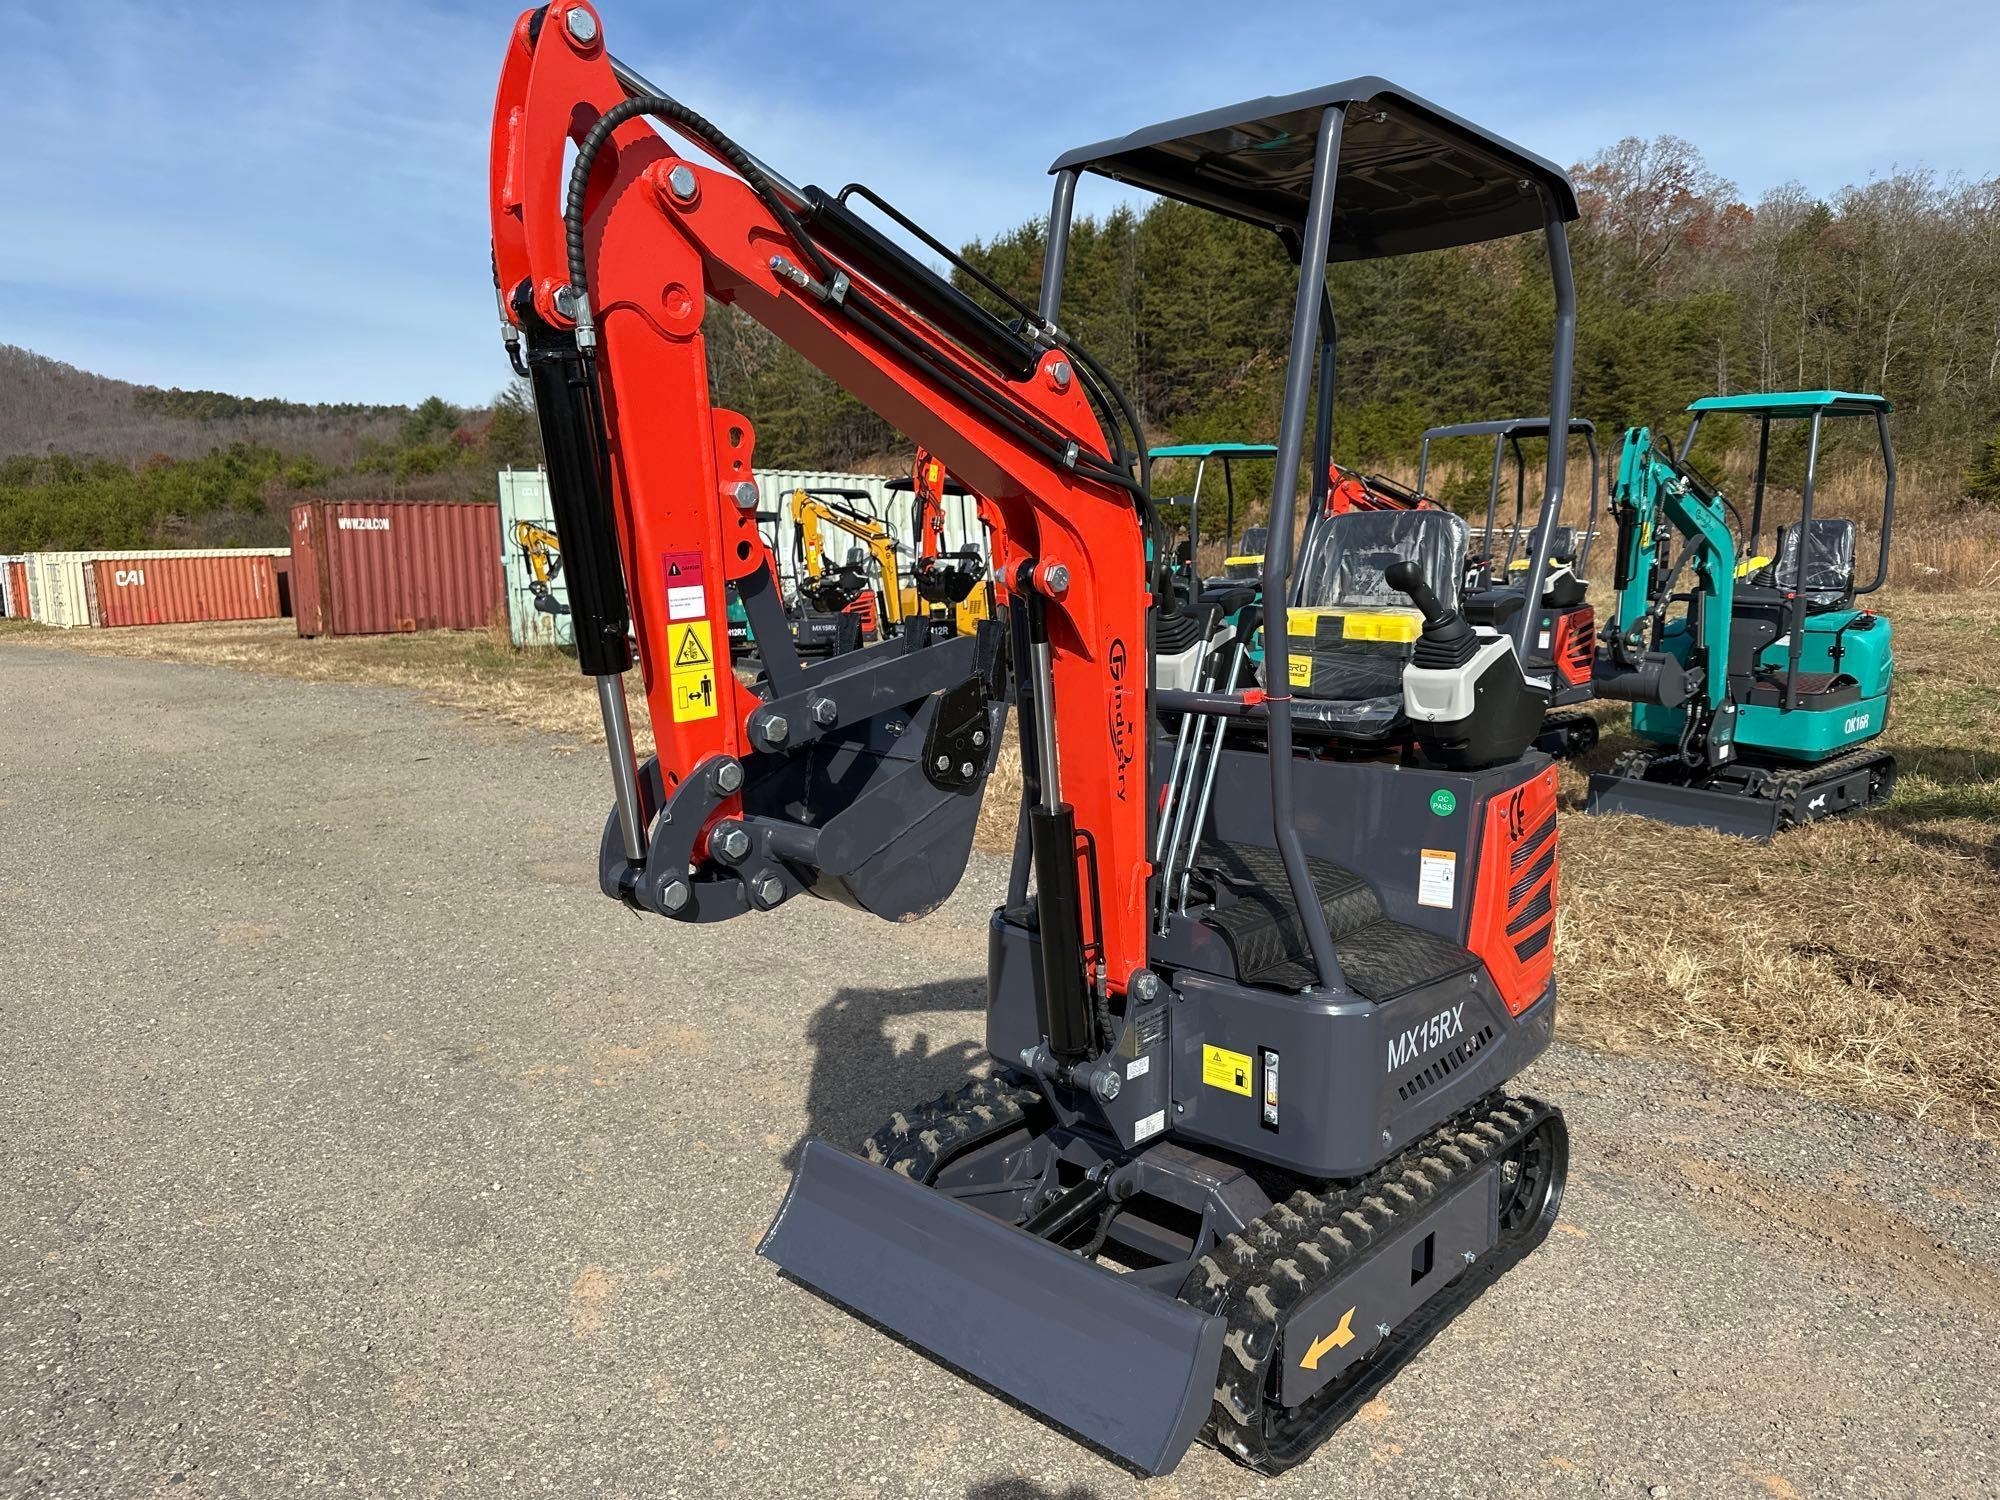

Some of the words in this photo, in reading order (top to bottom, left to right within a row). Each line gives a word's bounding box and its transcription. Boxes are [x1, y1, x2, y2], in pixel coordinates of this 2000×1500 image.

[115, 570, 146, 587] CAI
[1437, 795, 1449, 803] QC
[1432, 802, 1453, 811] PASS
[1387, 1001, 1465, 1074] MX15RX
